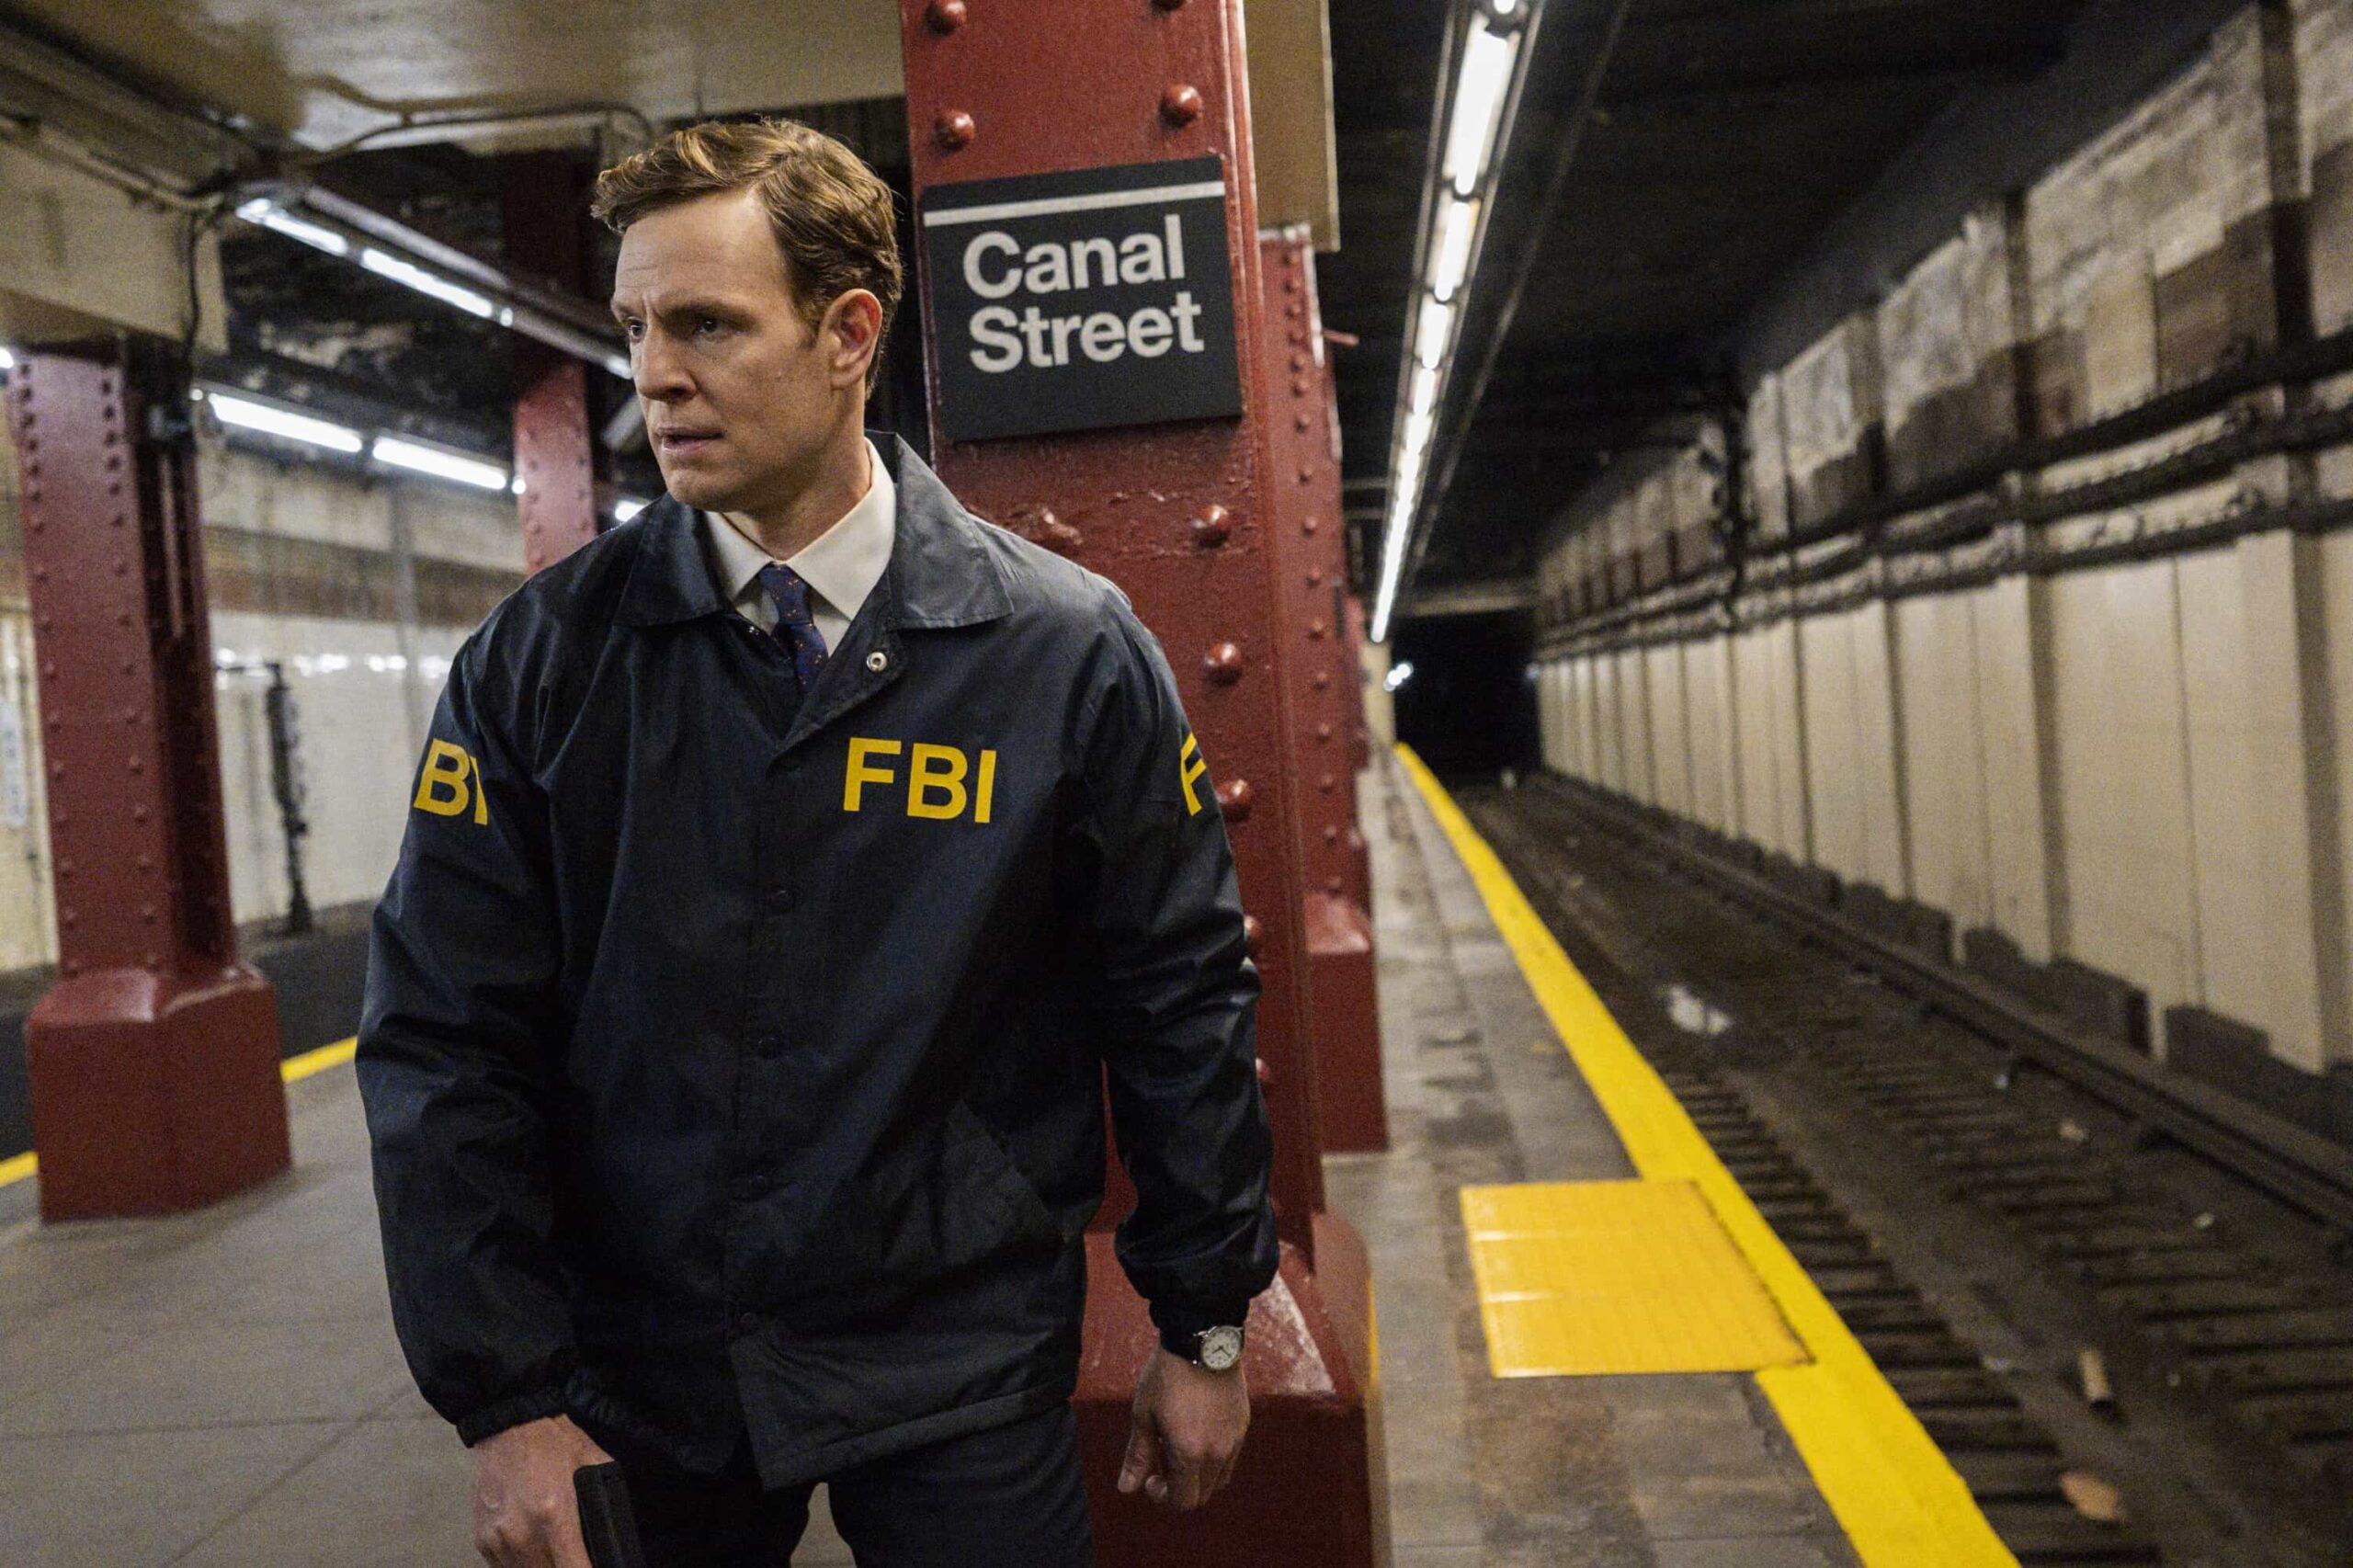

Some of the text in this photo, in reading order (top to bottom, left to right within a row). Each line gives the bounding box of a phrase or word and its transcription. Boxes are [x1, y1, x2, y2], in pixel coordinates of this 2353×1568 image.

[963, 213, 1186, 299] Canal
[969, 291, 1205, 373] Street
[843, 737, 997, 824] FBI
